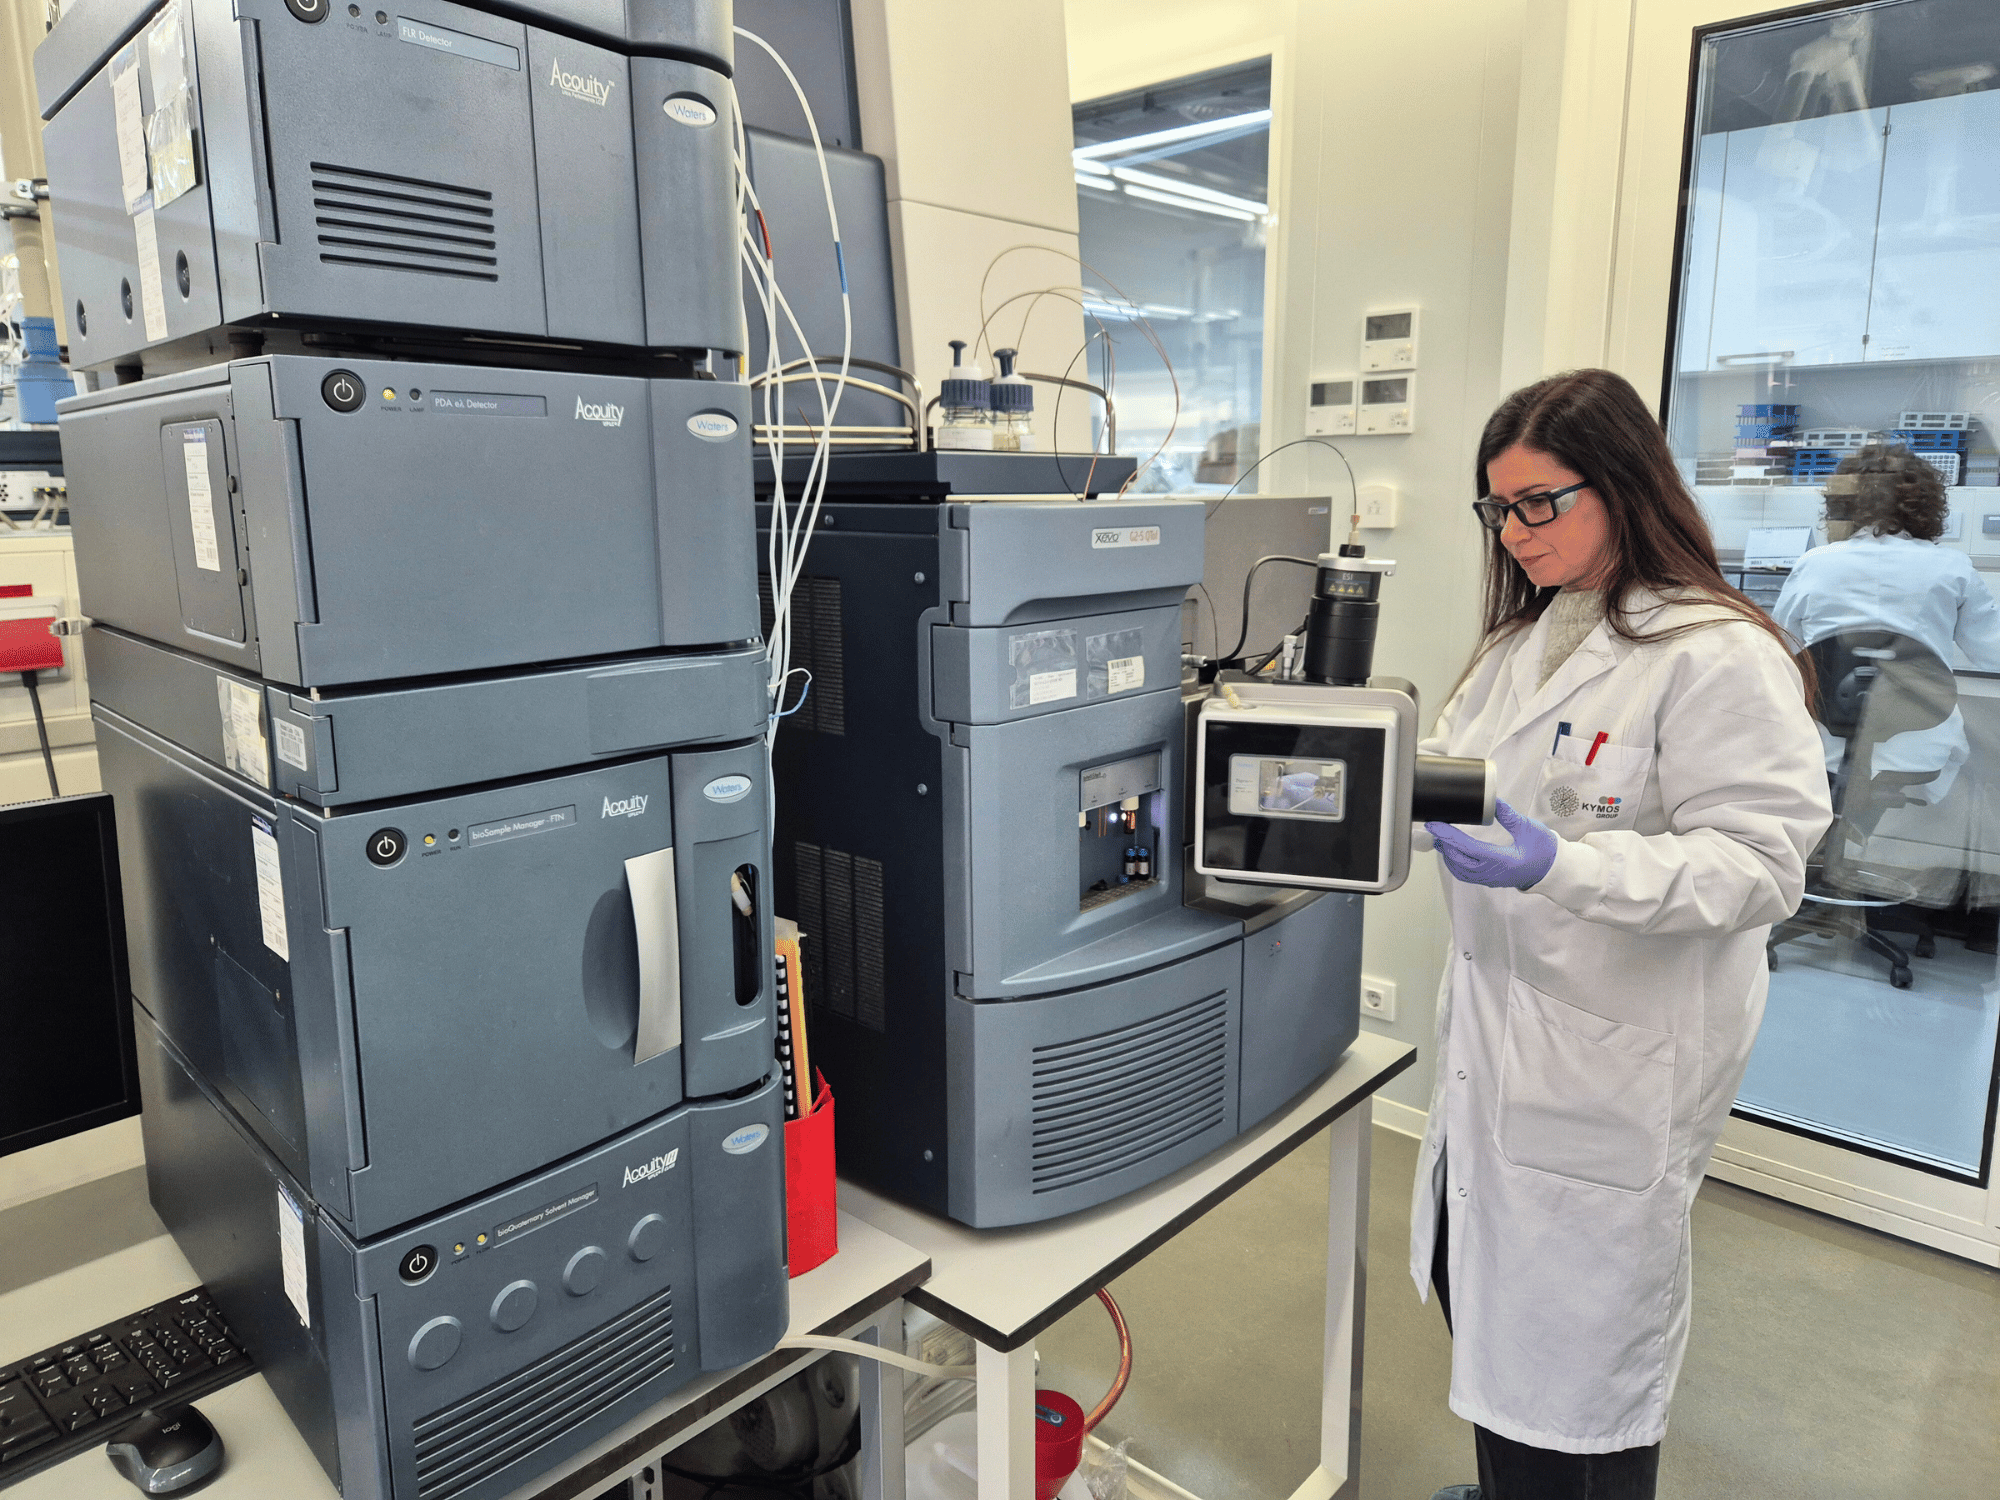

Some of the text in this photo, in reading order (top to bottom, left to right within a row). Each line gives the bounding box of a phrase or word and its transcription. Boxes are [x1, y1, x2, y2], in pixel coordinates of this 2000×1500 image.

[402, 26, 453, 47] FLR Detector
[673, 103, 707, 121] Waters
[434, 398, 452, 407] PDA
[466, 400, 498, 410] Detector
[696, 420, 729, 432] Waters
[711, 783, 743, 795] Waters
[1581, 802, 1620, 813] KYMOS
[472, 825, 512, 840] bioSample
[512, 818, 545, 831] Manager
[550, 813, 565, 823] FTN
[421, 849, 442, 858] POWER
[731, 1130, 762, 1146] Waters
[497, 1189, 596, 1237] bioQuaternary Solvent Manager
[161, 1421, 181, 1434] logi
